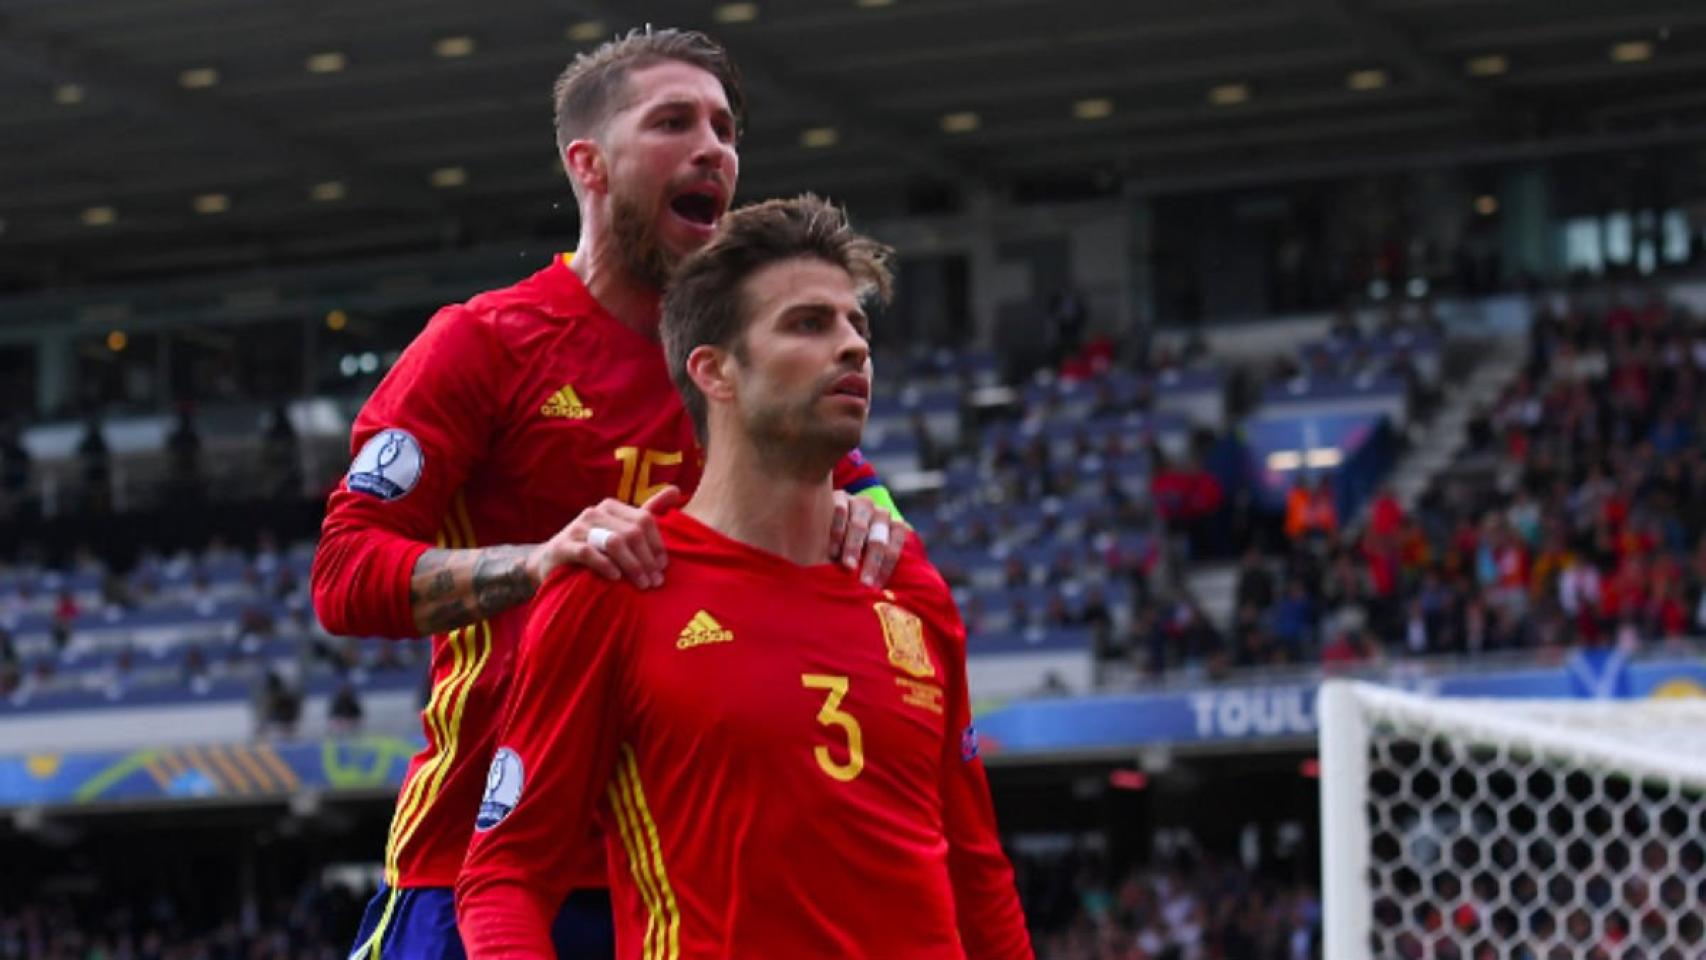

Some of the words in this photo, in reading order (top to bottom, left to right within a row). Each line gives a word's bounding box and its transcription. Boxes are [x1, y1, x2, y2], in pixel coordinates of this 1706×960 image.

[541, 405, 593, 419] adidas
[614, 446, 683, 506] 15
[676, 630, 734, 649] adidas
[802, 674, 864, 782] 3
[1188, 685, 1317, 737] TOUL
